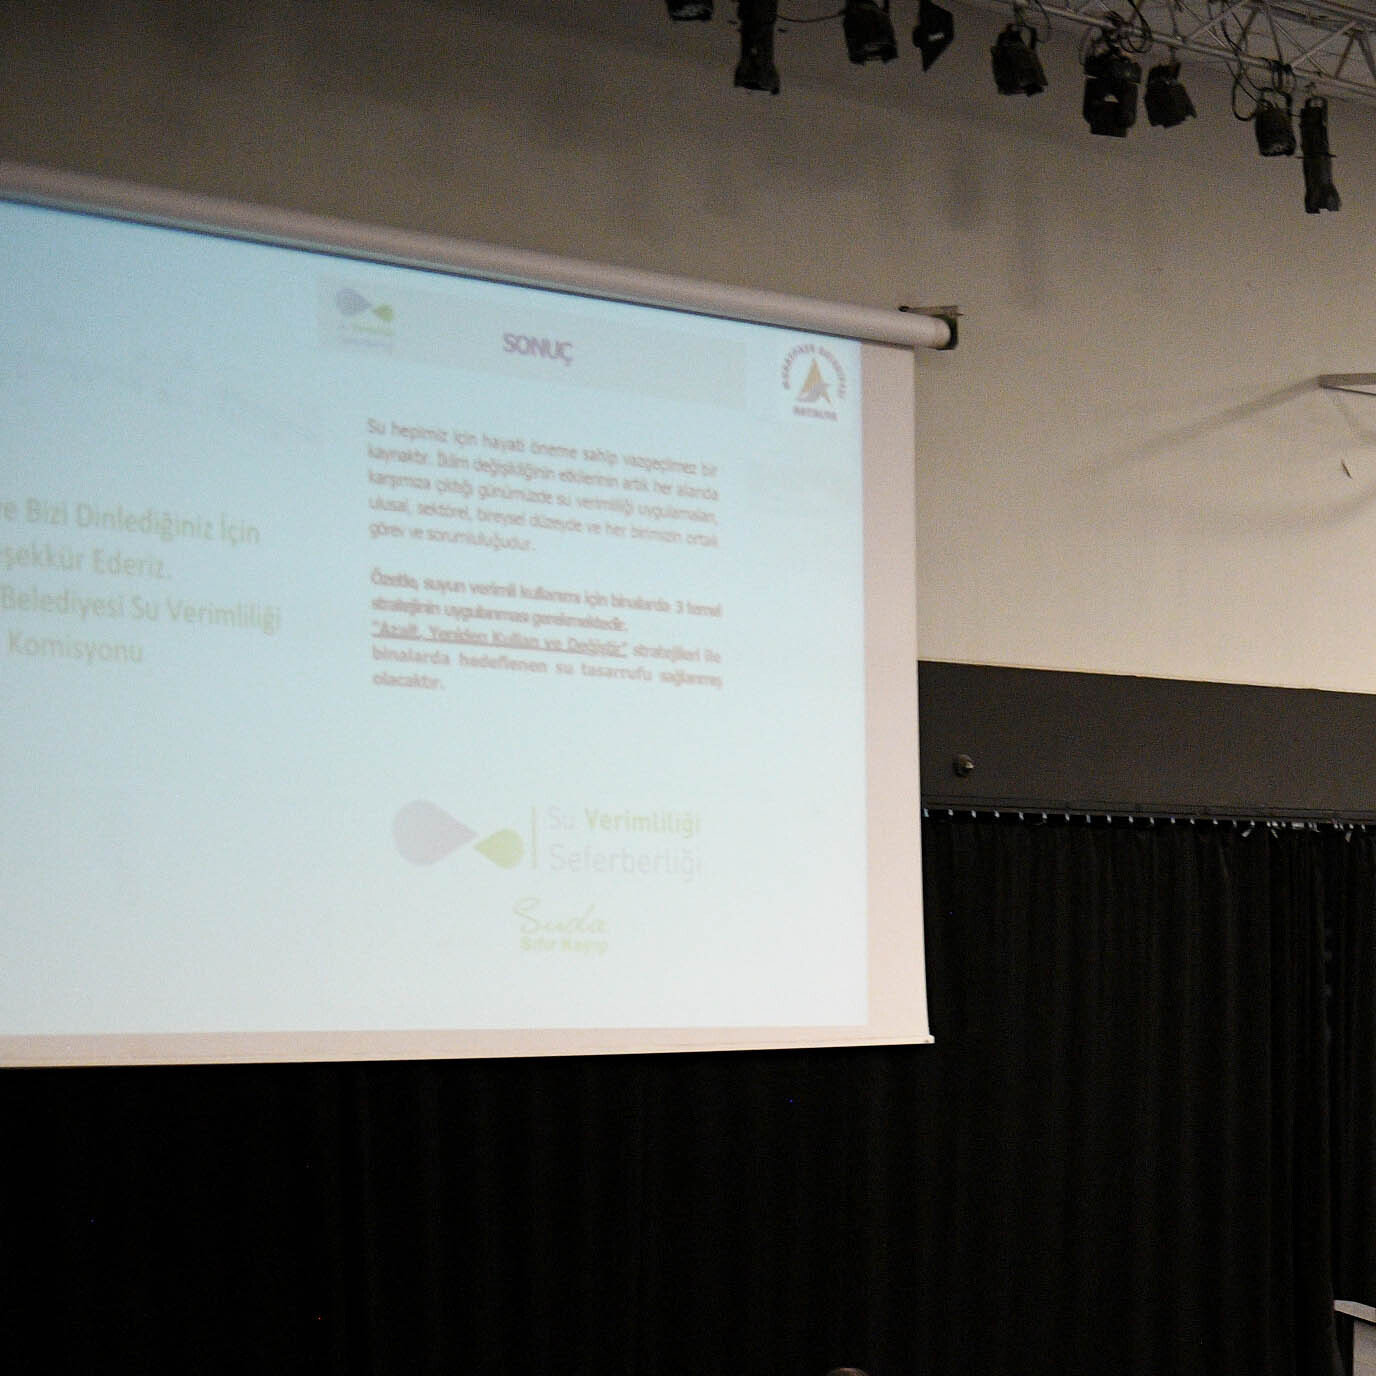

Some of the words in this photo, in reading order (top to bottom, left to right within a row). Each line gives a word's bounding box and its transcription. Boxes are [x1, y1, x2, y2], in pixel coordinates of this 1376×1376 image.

[502, 330, 574, 368] SONUÇ
[1, 501, 19, 522] e
[26, 496, 69, 526] Bizi
[76, 502, 214, 542] Dinlediğiniz
[220, 510, 261, 547] İçin
[2, 542, 84, 571] şekkür
[92, 546, 173, 580] Ederiz.
[0, 584, 124, 622] Belediyesi
[131, 594, 160, 622] Su
[166, 596, 282, 638] Verimliliği
[7, 628, 143, 667] Komisyonu
